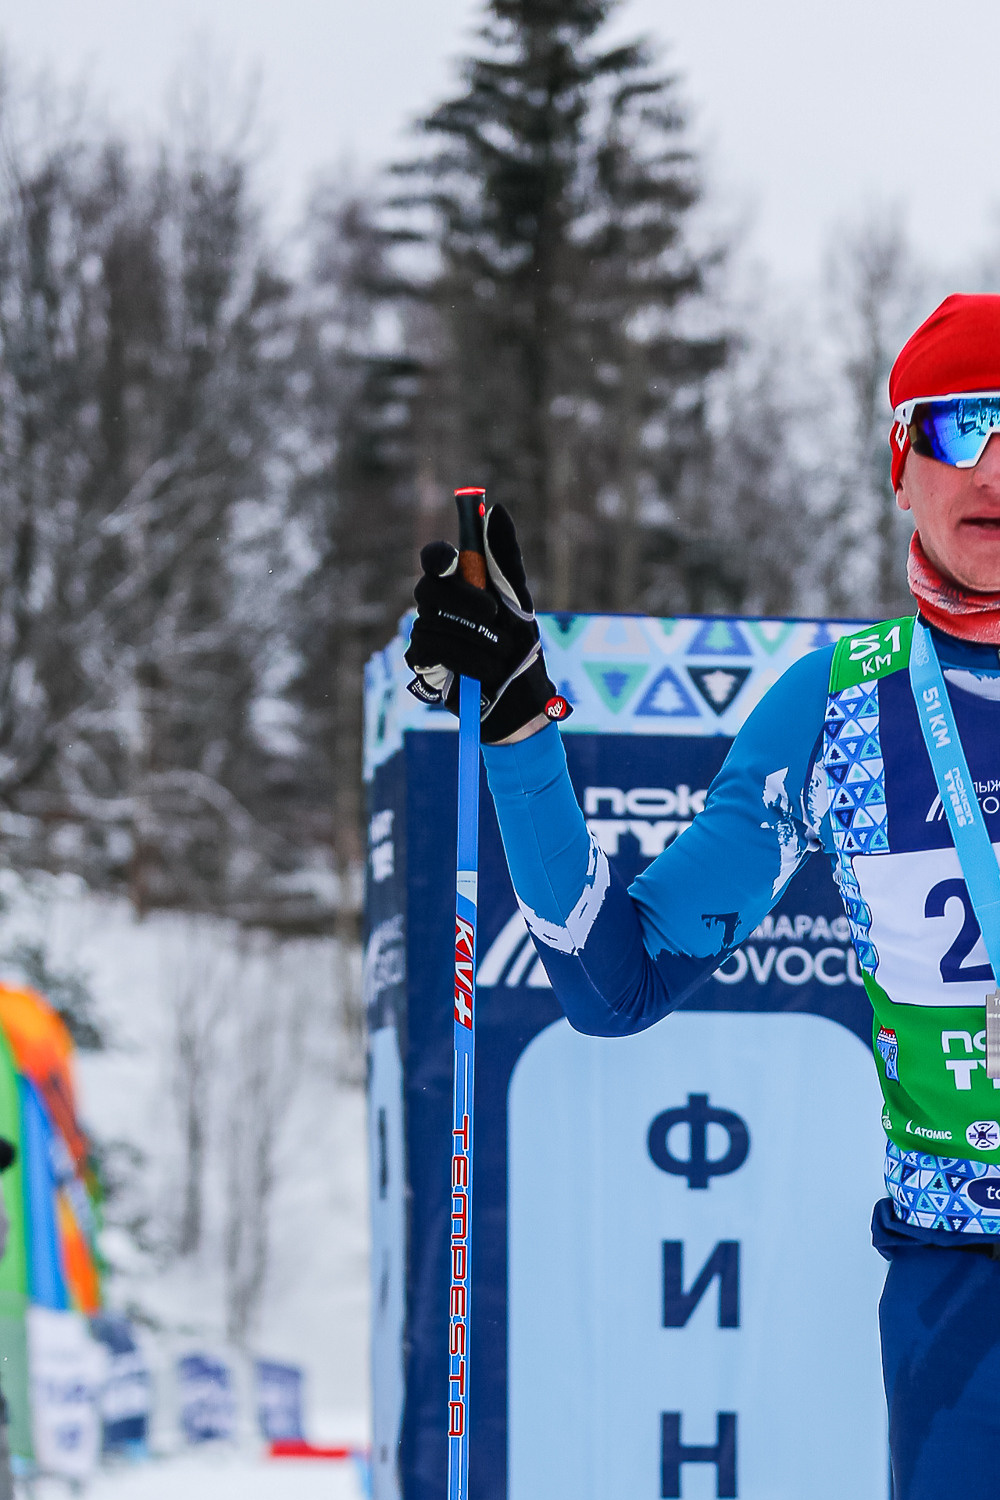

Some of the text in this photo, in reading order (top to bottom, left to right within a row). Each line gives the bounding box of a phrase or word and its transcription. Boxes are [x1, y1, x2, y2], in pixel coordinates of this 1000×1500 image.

[848, 625, 901, 661] 51
[923, 686, 941, 712] 51
[584, 784, 706, 818] nok
[943, 769, 968, 828] TYRES
[914, 1126, 953, 1141] ATOMIC
[448, 1114, 470, 1438] TEMPESTA
